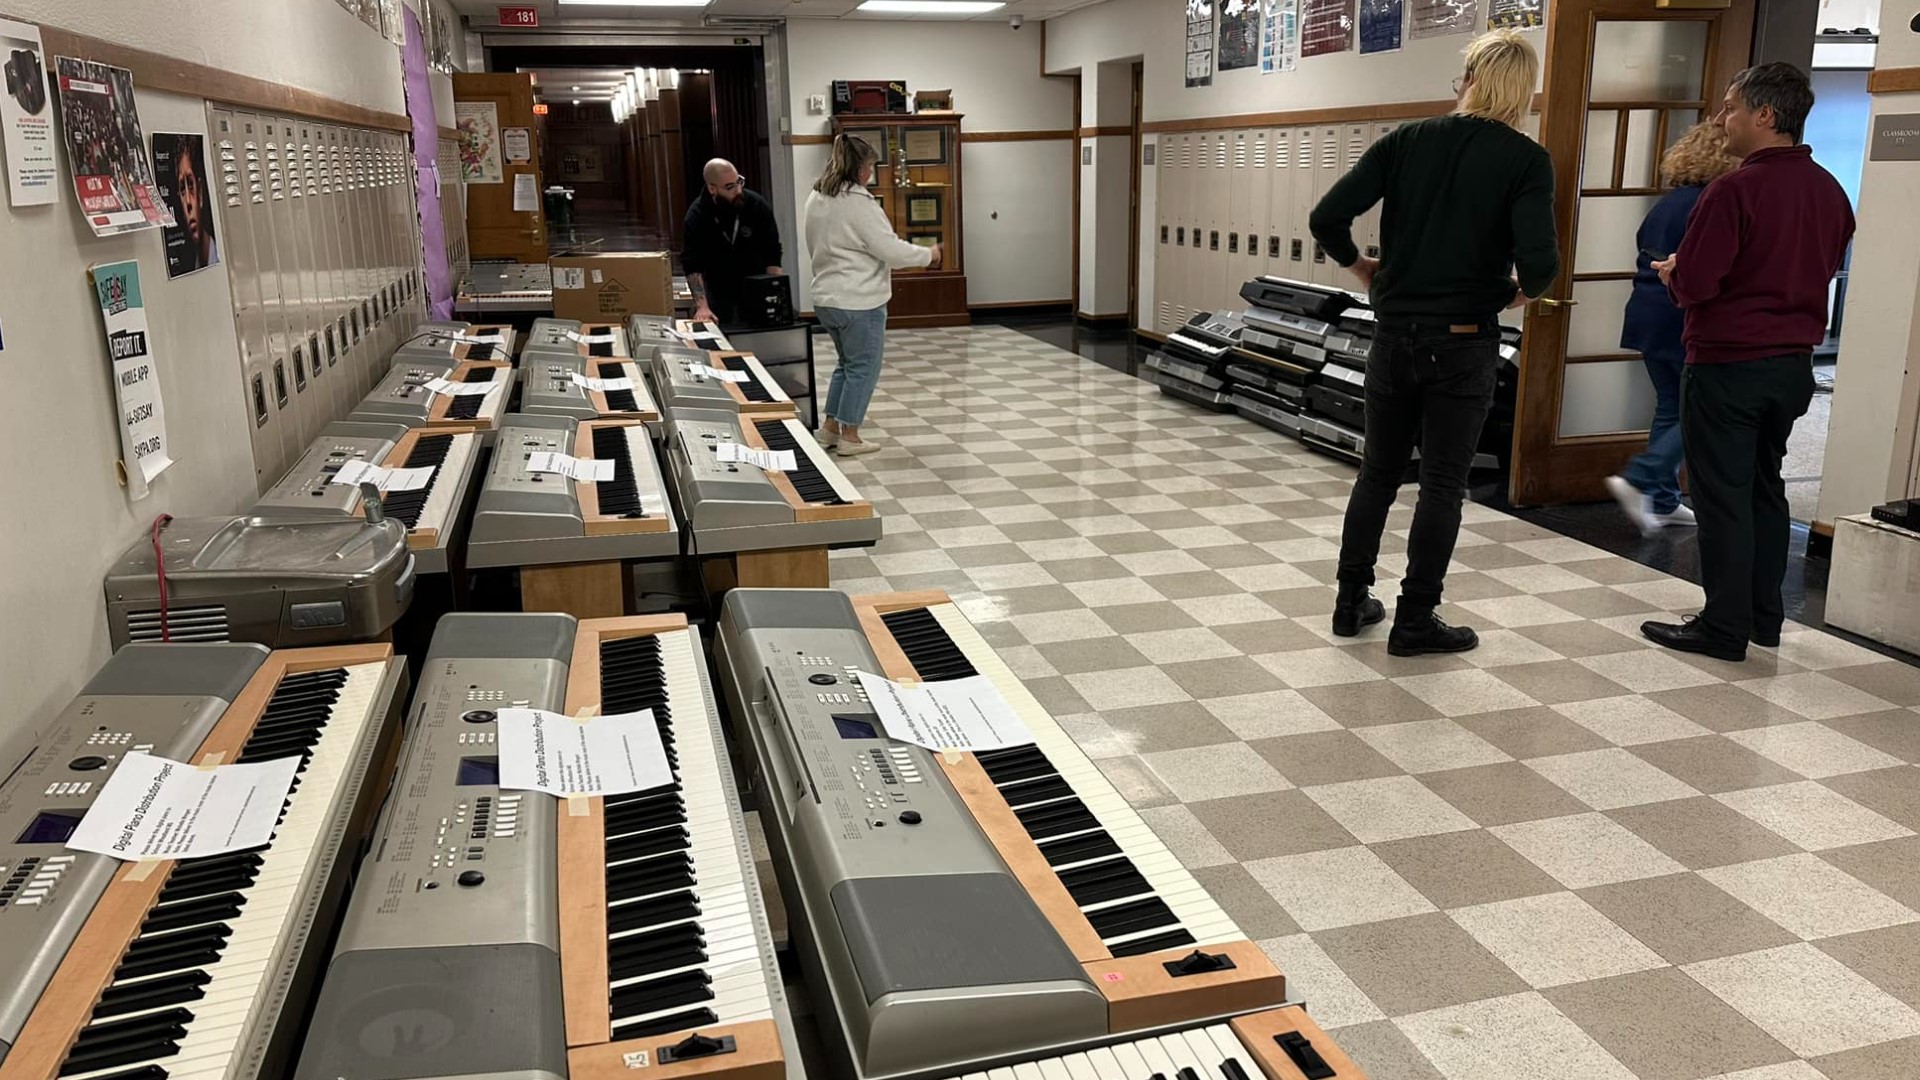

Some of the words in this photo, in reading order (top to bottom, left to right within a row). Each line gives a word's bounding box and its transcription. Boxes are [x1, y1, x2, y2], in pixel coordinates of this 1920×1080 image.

[516, 11, 534, 22] 181
[112, 336, 134, 357] REPORT
[121, 367, 138, 387] MOBILE
[137, 365, 149, 381] APP
[532, 712, 544, 728] Project
[534, 728, 545, 754] Distribution
[536, 755, 546, 769] Piano
[537, 769, 550, 787] Digital
[112, 830, 132, 851] Digital
[124, 814, 143, 832] Piano
[134, 783, 160, 814] Distribution
[154, 763, 174, 783] Project
